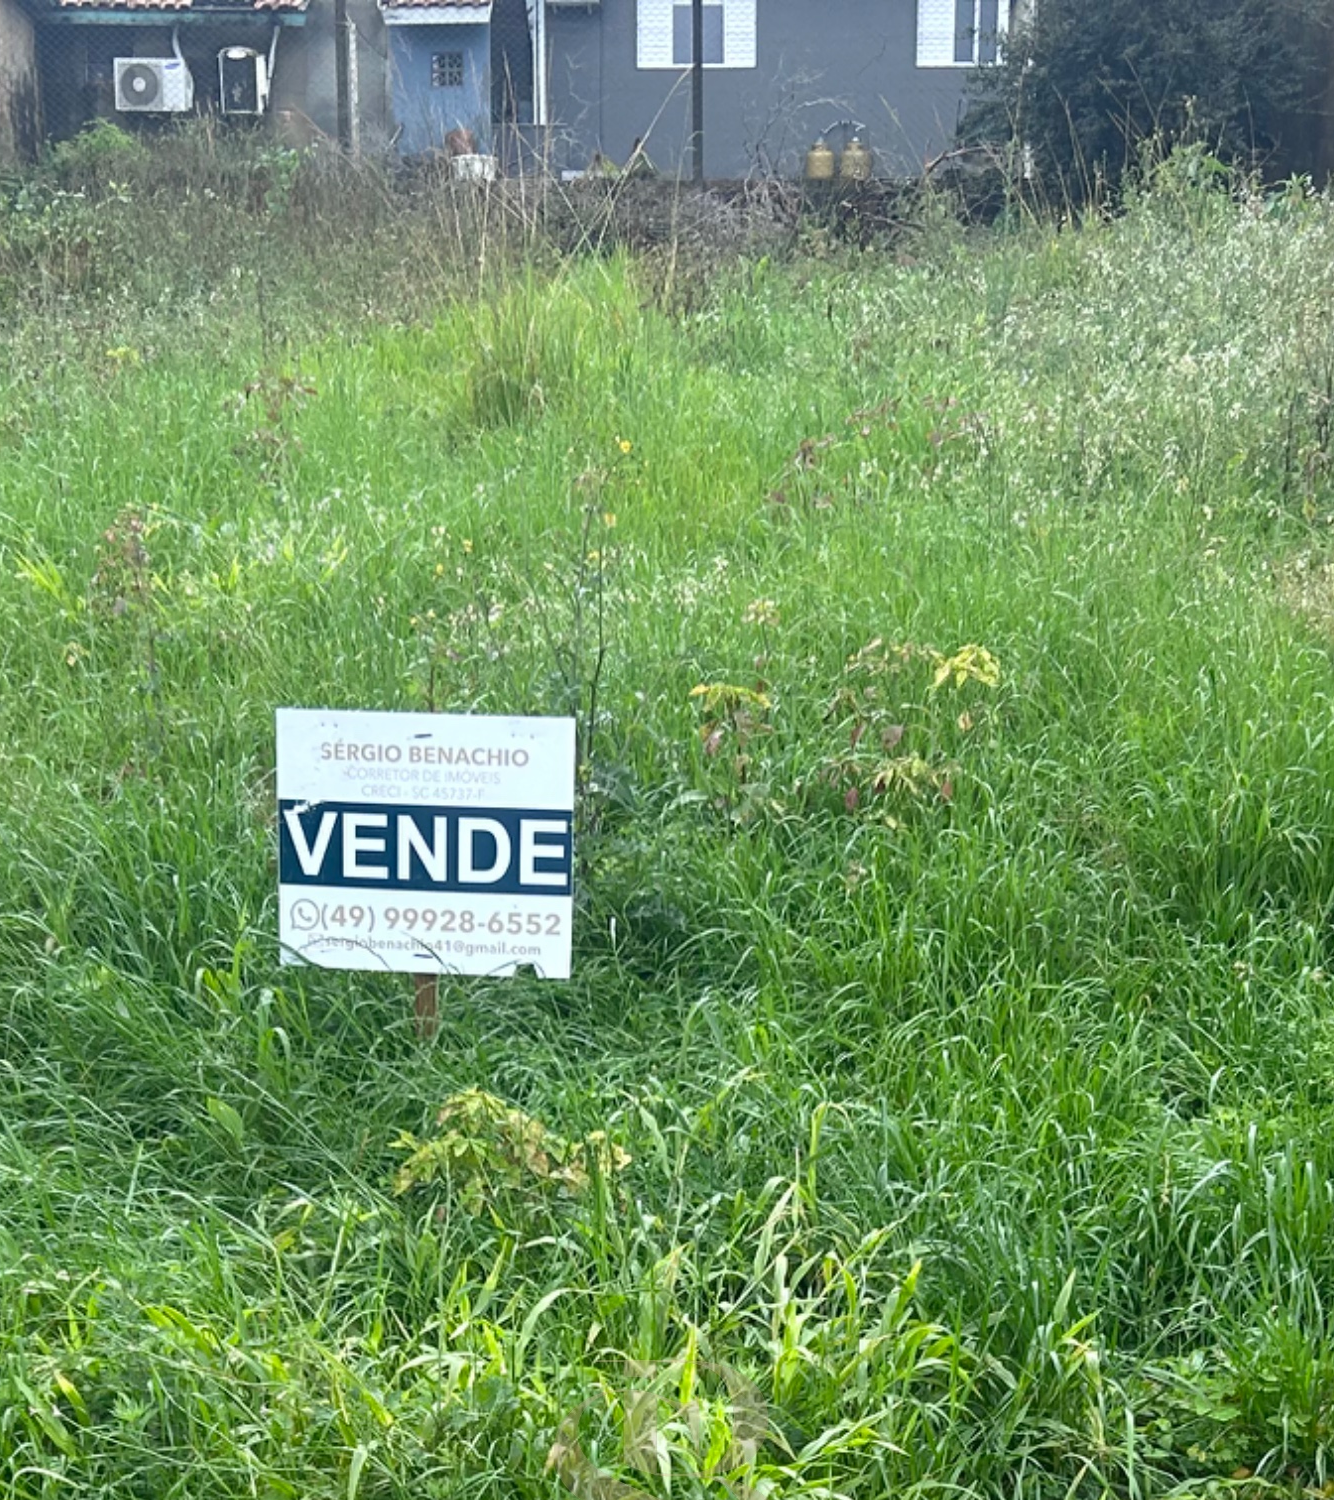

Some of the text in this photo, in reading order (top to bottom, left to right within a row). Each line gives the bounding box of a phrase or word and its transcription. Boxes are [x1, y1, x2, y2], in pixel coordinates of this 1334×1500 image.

[320, 738, 530, 768] SÉRGIO BENACHIO
[346, 767, 501, 785] CORRETOR DE IMÓVEIS
[361, 784, 401, 799] CRECI
[411, 787, 430, 800] SC
[283, 810, 568, 886] VENDE
[320, 903, 562, 937] (49) 99928-6552
